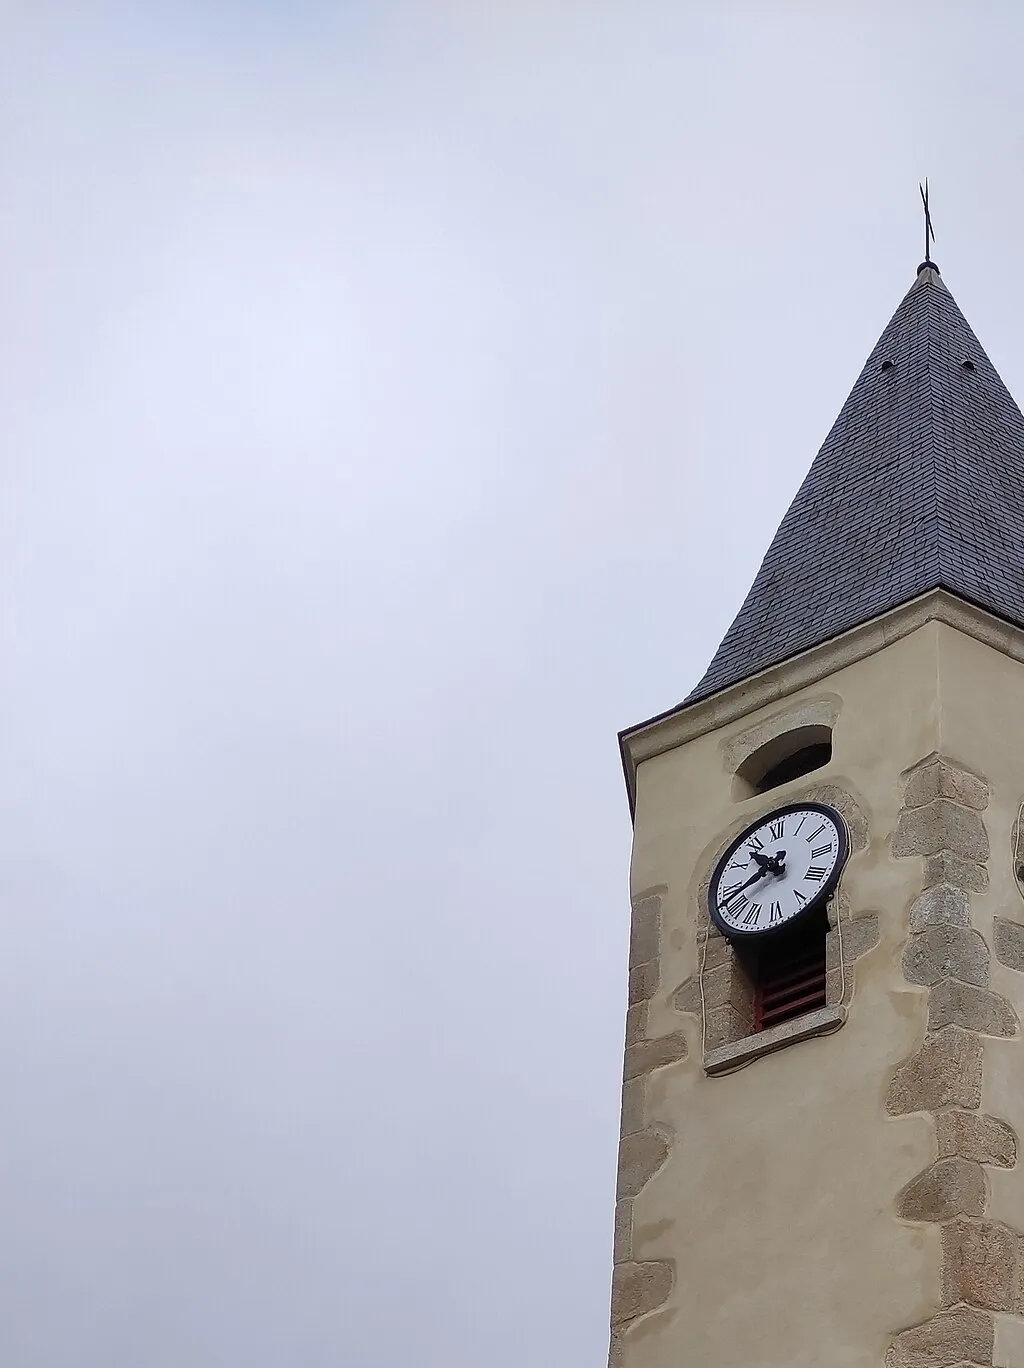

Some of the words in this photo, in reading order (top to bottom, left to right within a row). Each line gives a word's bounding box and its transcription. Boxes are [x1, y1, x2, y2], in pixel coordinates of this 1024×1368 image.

[769, 820, 786, 843] XII
[793, 817, 808, 836] I
[805, 824, 826, 843] II
[745, 834, 765, 852] XI
[811, 843, 833, 860] III
[730, 861, 749, 870] X
[803, 865, 828, 882] IIII
[727, 892, 750, 920] VIII
[792, 889, 808, 905] V
[742, 903, 763, 925] VII
[769, 901, 784, 923] VI
